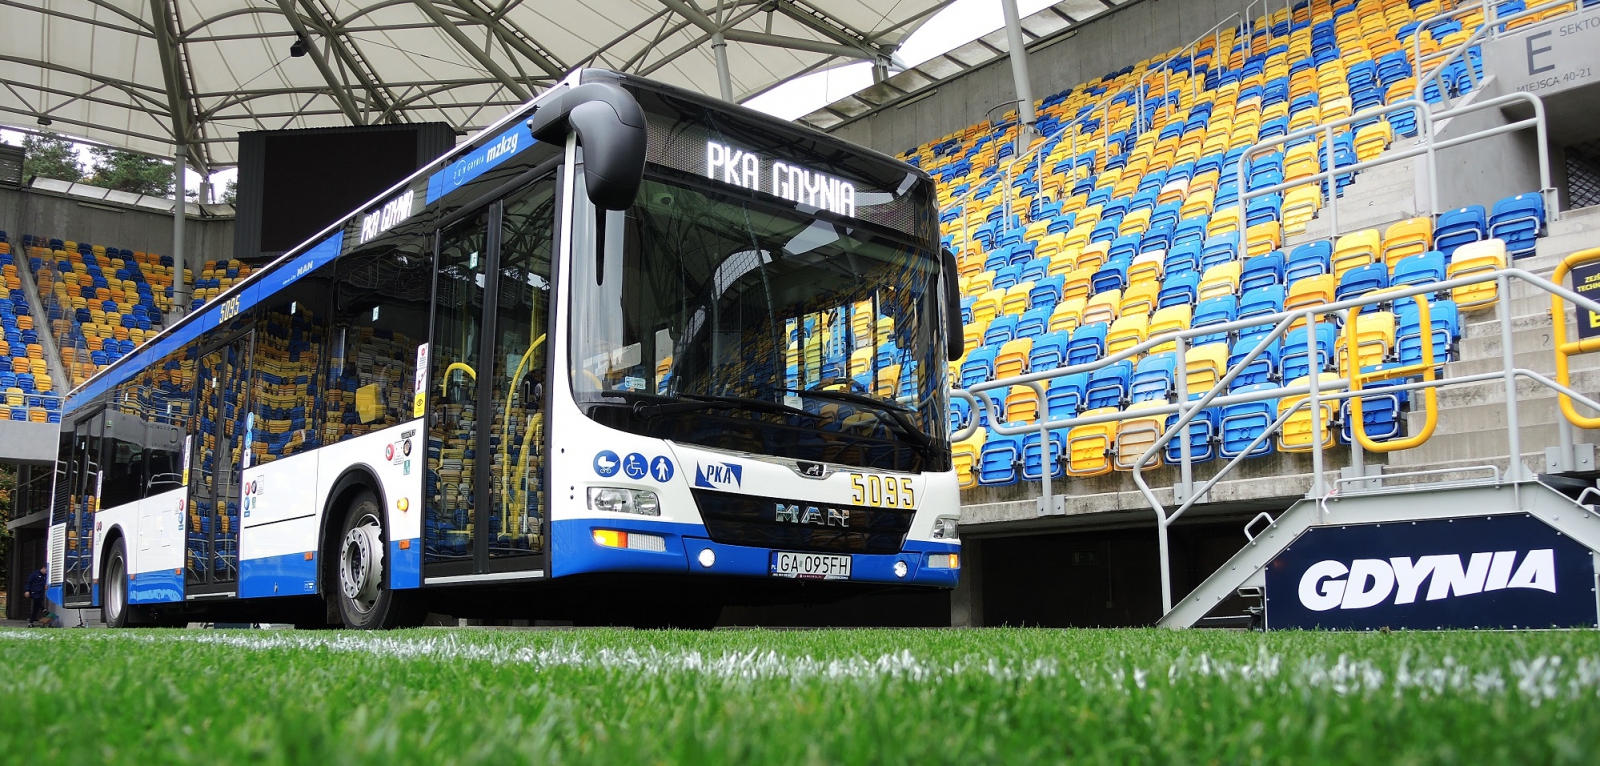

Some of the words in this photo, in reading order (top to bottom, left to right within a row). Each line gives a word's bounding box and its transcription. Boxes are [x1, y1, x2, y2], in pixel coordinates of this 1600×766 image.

[1526, 30, 1555, 76] E
[1559, 16, 1600, 37] SEKTO
[1516, 76, 1560, 93] MIEJSCA
[1563, 67, 1592, 82] 40-21
[486, 132, 519, 163] mzkzg
[707, 141, 759, 191] PKA
[772, 161, 855, 218] GDYNIA
[360, 209, 380, 244] PKA
[381, 189, 414, 232] GDYNIA
[296, 260, 314, 277] MAN
[219, 293, 241, 324] 5095
[705, 464, 732, 484] PKA
[850, 473, 915, 509] 5095
[775, 503, 850, 527] MAN
[780, 554, 799, 573] GA
[804, 555, 848, 575] 095FH
[1298, 549, 1557, 611] GDYNIA
